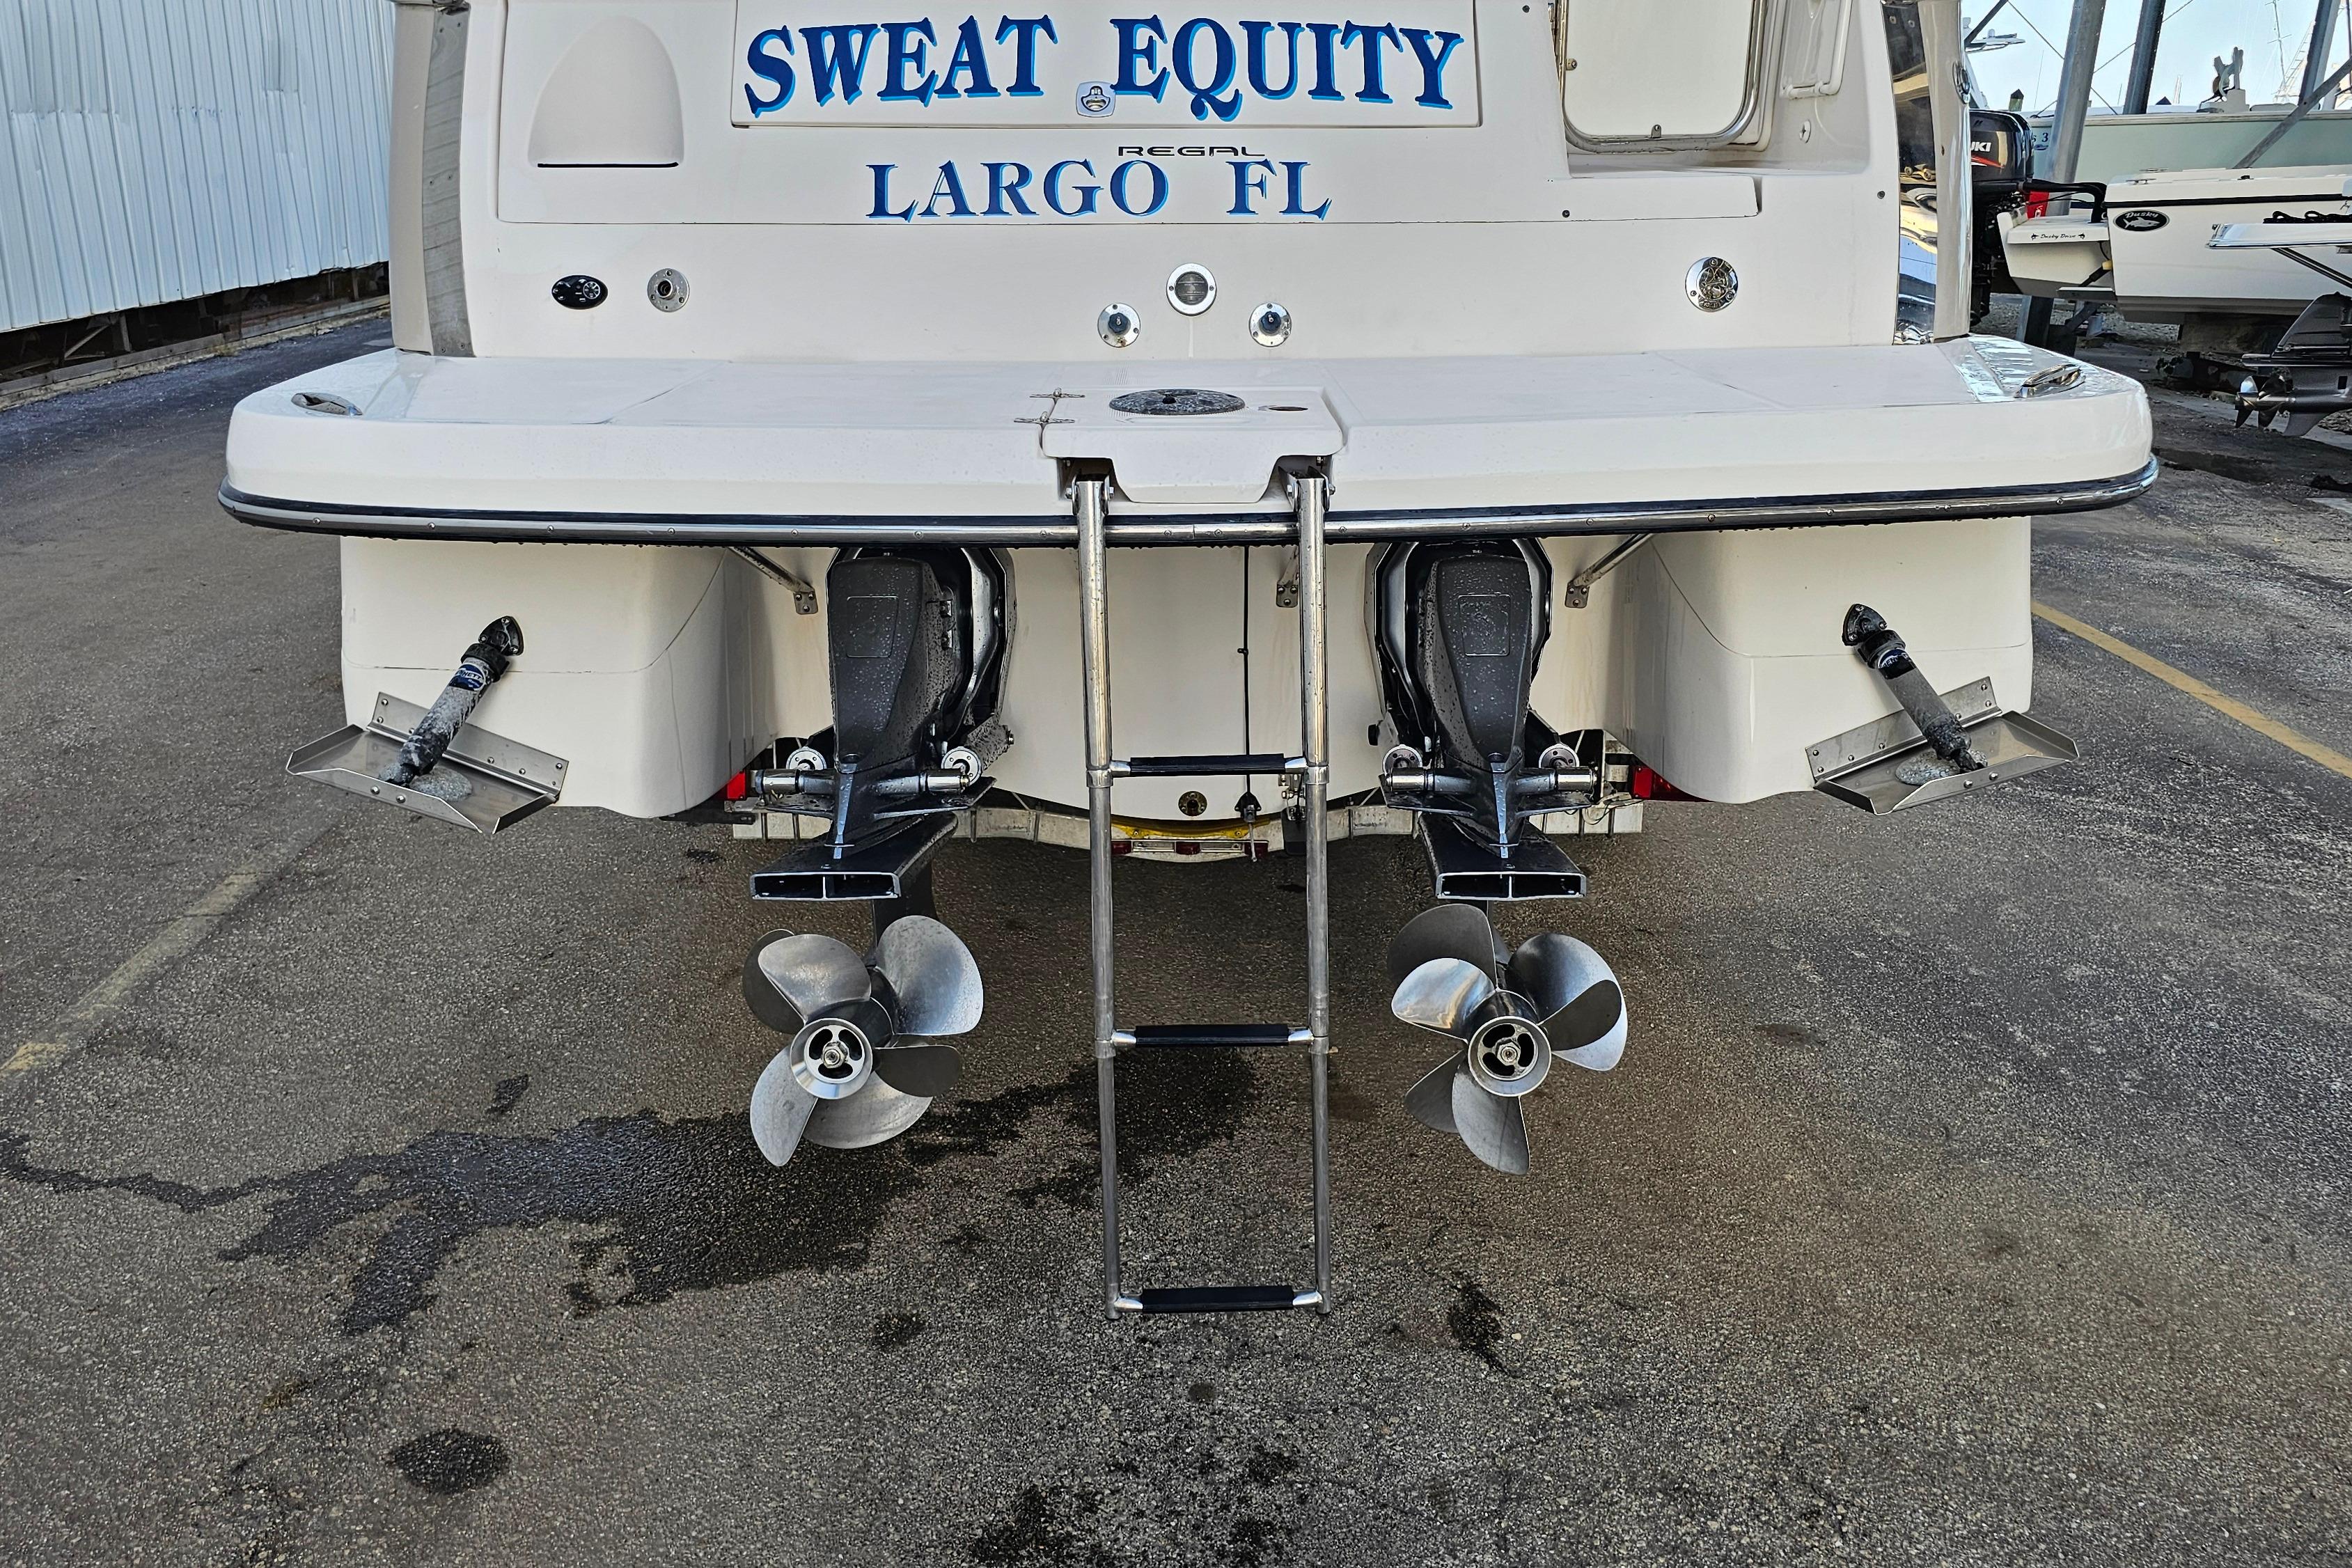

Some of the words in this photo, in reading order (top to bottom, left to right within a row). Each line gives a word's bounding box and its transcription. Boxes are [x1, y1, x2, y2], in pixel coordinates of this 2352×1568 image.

[744, 15, 1058, 118] SWEAT
[1109, 14, 1464, 122] EQUITY
[1118, 146, 1266, 157] REGAL
[865, 158, 1169, 222] LARGO
[1225, 157, 1333, 221] FL
